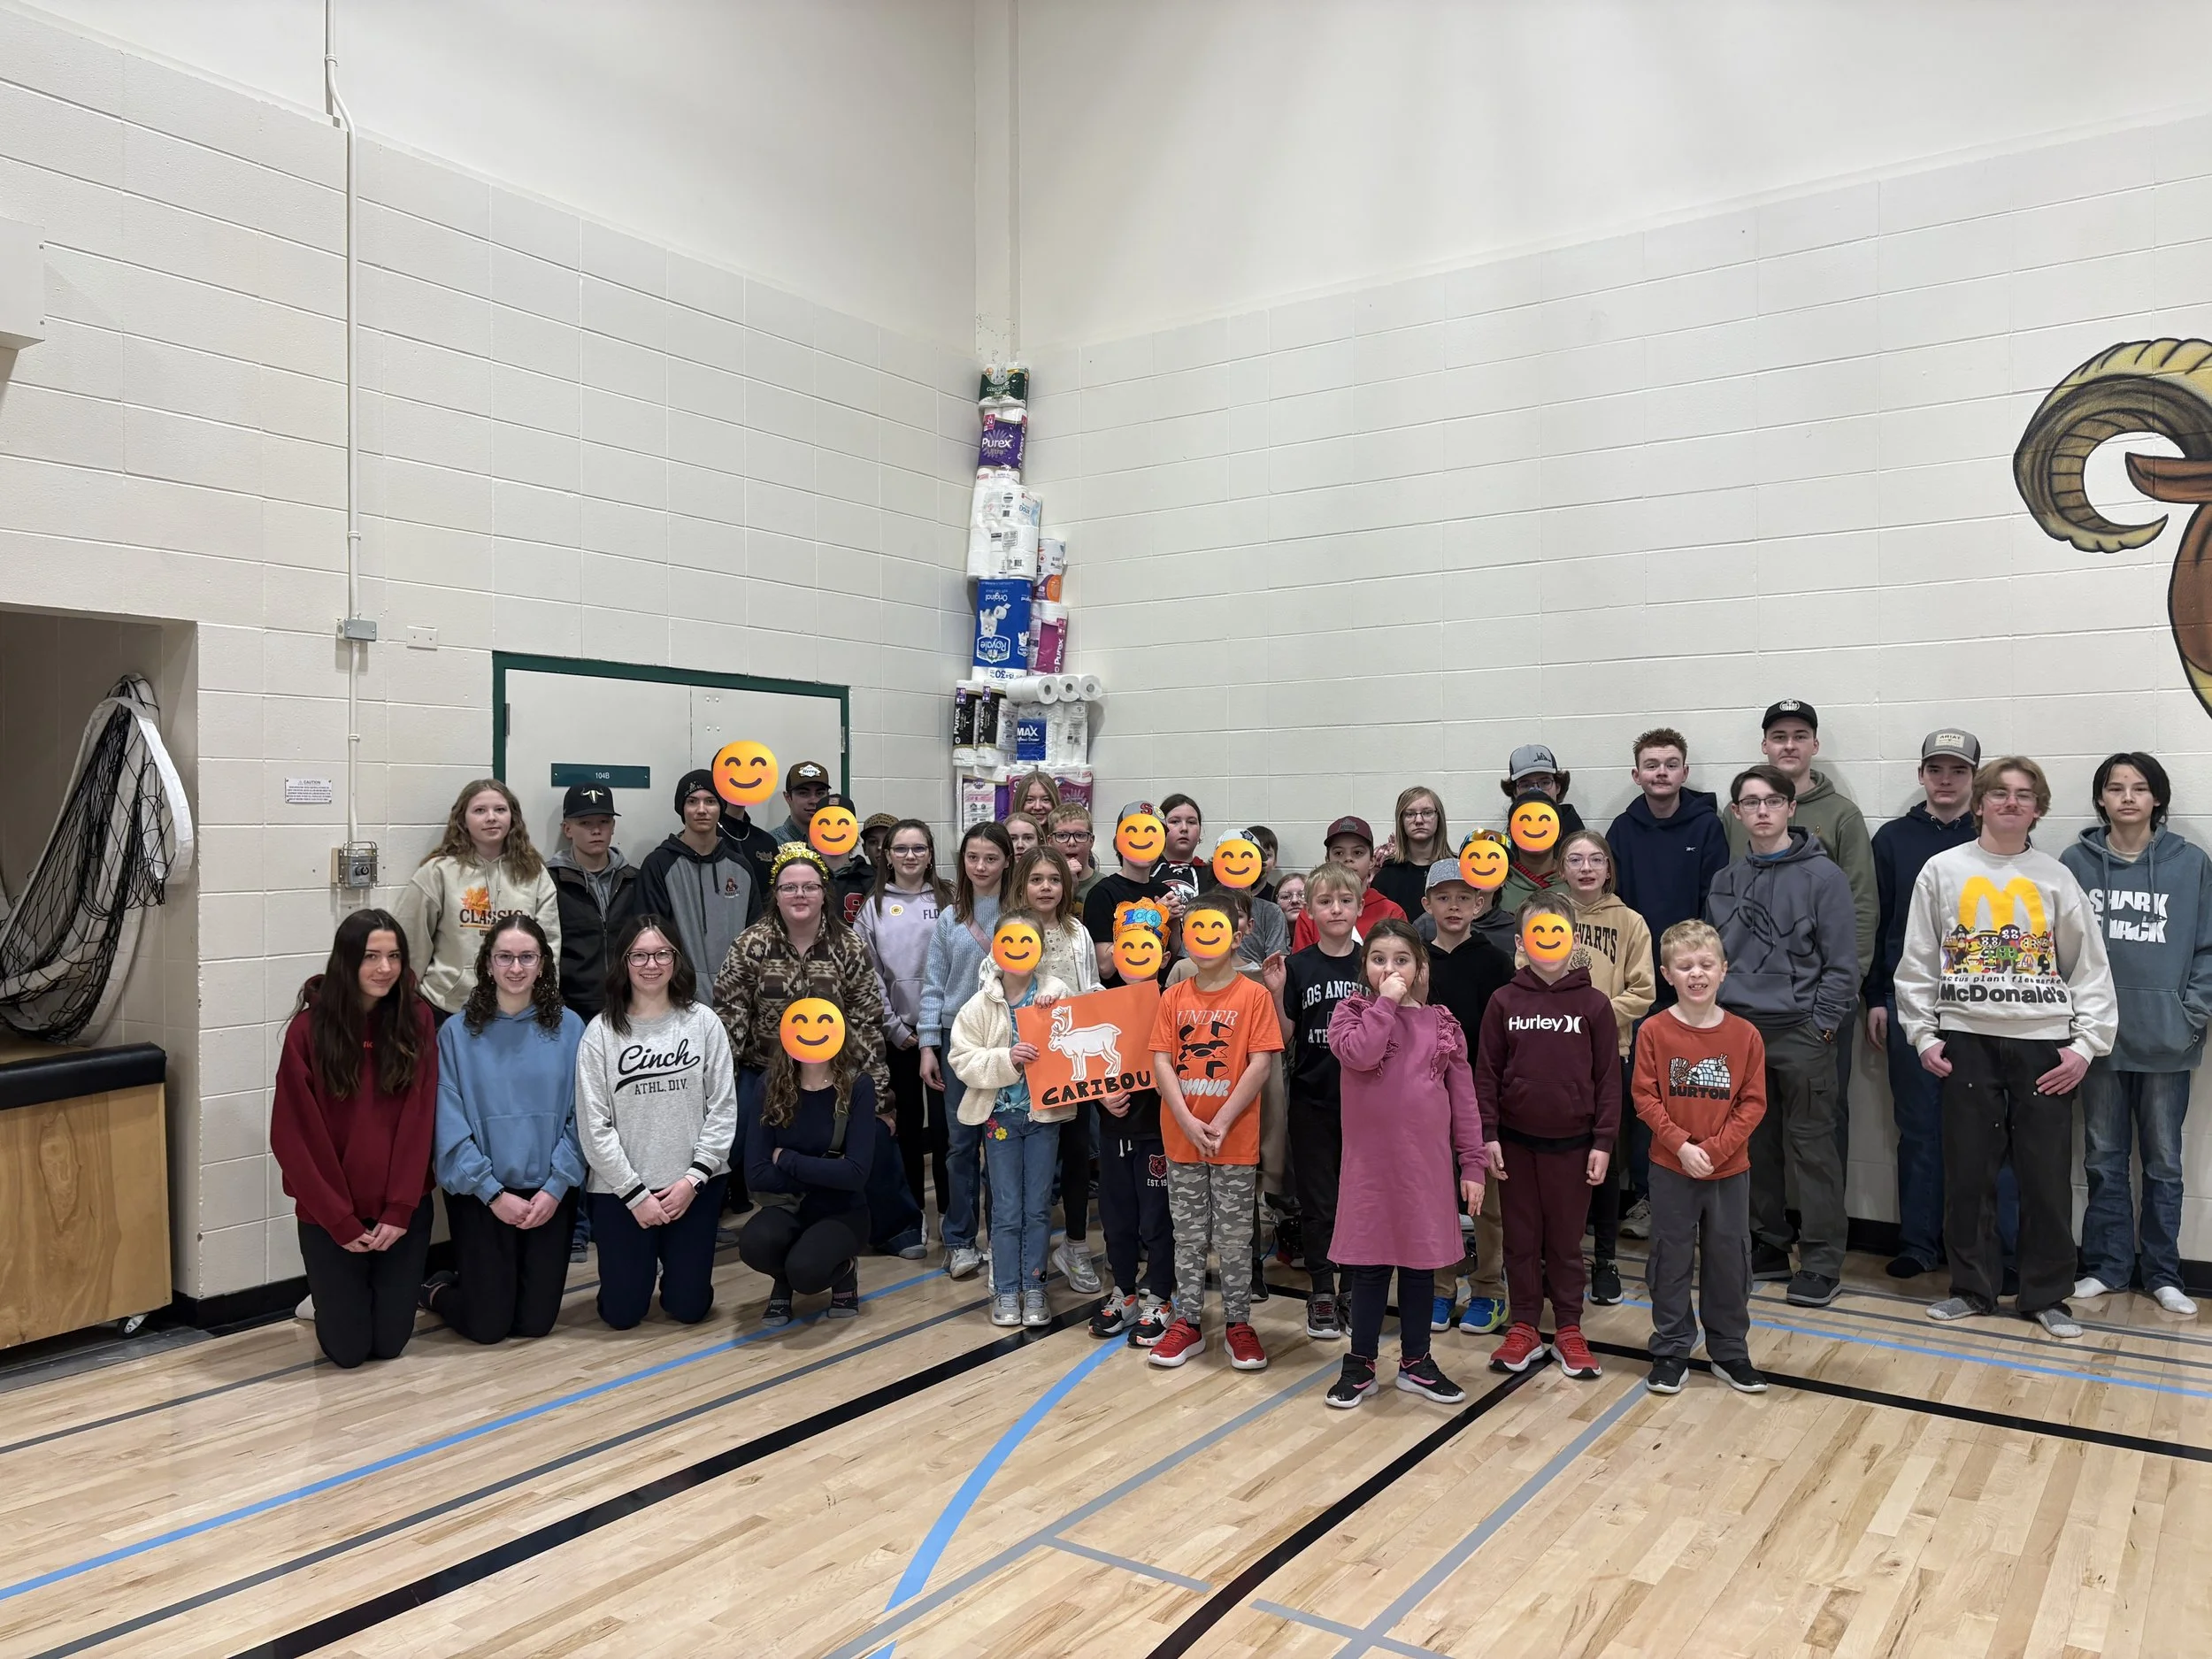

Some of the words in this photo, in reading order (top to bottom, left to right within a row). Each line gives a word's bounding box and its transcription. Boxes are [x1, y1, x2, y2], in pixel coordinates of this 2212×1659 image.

[981, 438, 1012, 448] Purex
[985, 593, 1008, 602] Original
[980, 638, 1007, 651] Royale
[1054, 639, 1064, 665] Purex
[1141, 803, 1153, 815] S
[2089, 888, 2170, 918] SHARK
[1122, 908, 1163, 929] 100
[1575, 922, 1618, 965] WARTS
[1973, 975, 2006, 984] plant
[1302, 983, 1322, 1010] LOS
[1939, 983, 2068, 1003] McDonald's
[1177, 1010, 1238, 1026] UNDER
[1508, 1014, 1563, 1032] Hurley
[618, 1038, 701, 1075] Cinch
[634, 1080, 666, 1095] ATHL.
[668, 1079, 688, 1092] DIV.
[1041, 1071, 1151, 1105] CARIBOU
[1669, 1085, 1731, 1100] BURTON
